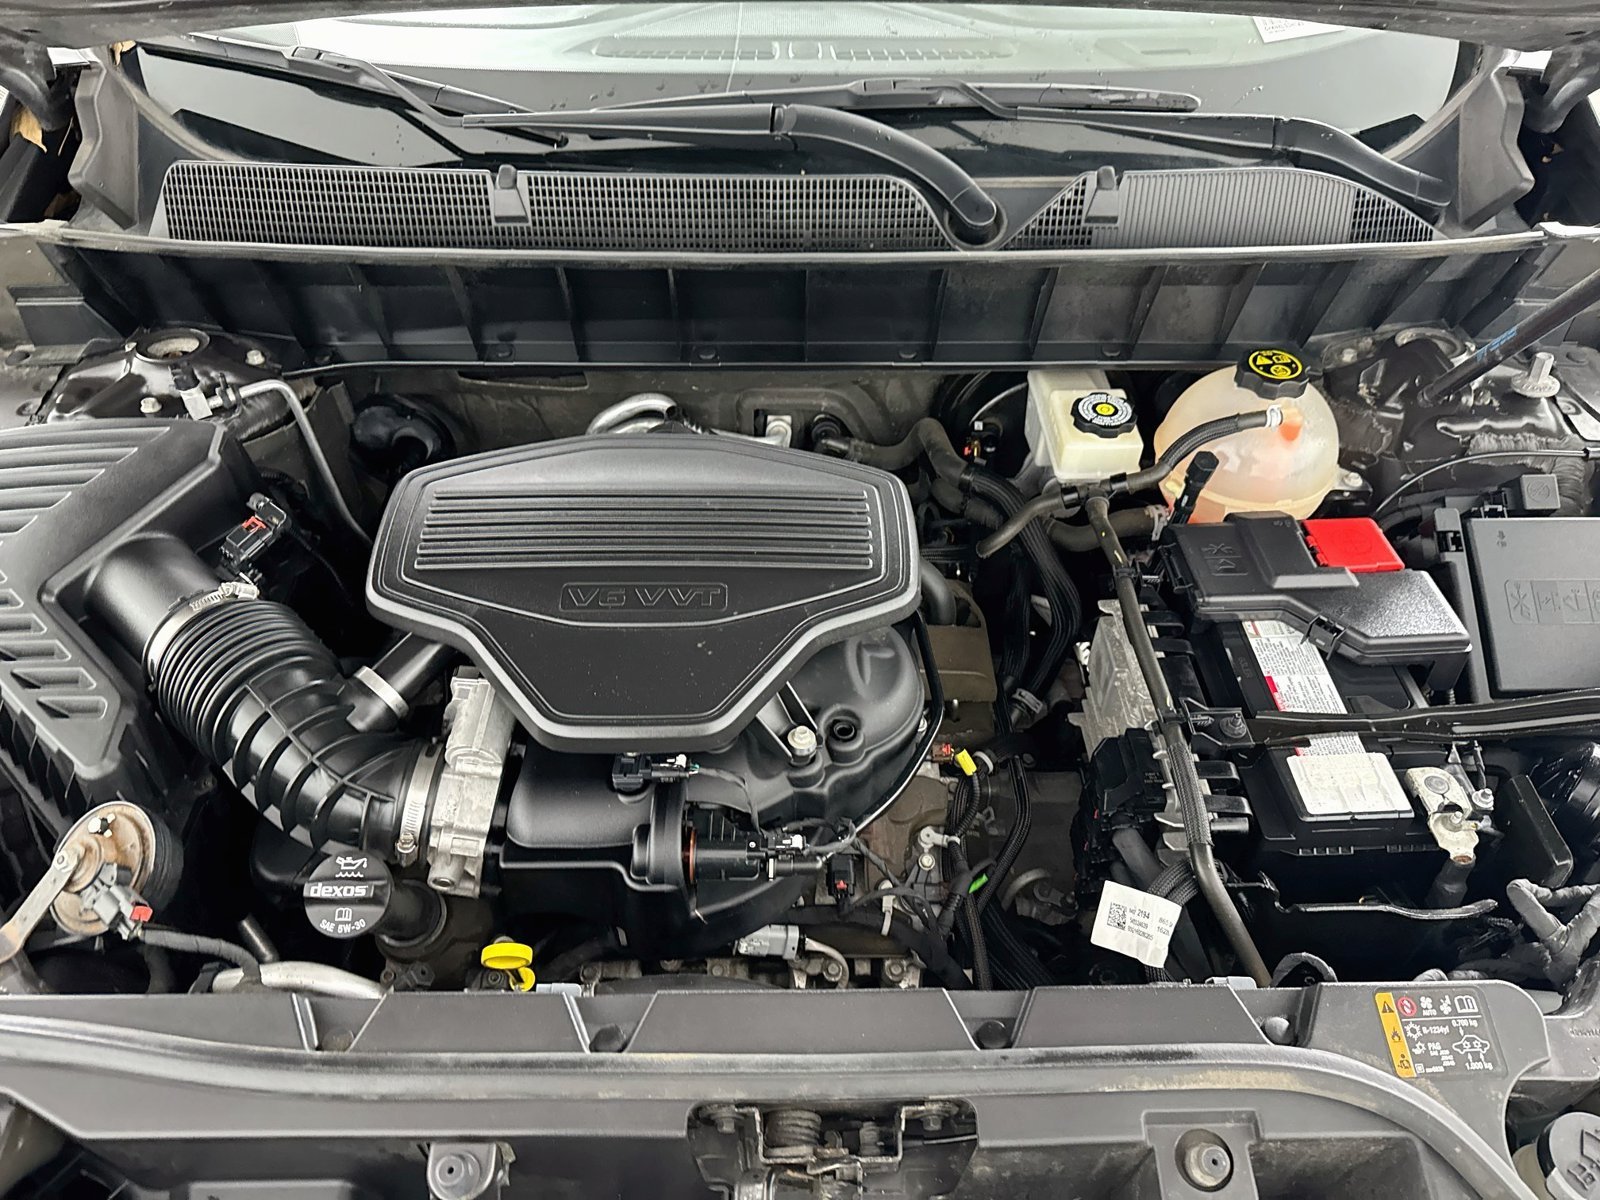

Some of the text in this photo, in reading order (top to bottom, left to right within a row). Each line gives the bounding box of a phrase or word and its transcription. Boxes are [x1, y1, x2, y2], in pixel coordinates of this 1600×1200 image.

[568, 588, 721, 606] V6 VVT
[310, 882, 368, 897] dexos
[320, 918, 366, 934] SAE 5W-30
